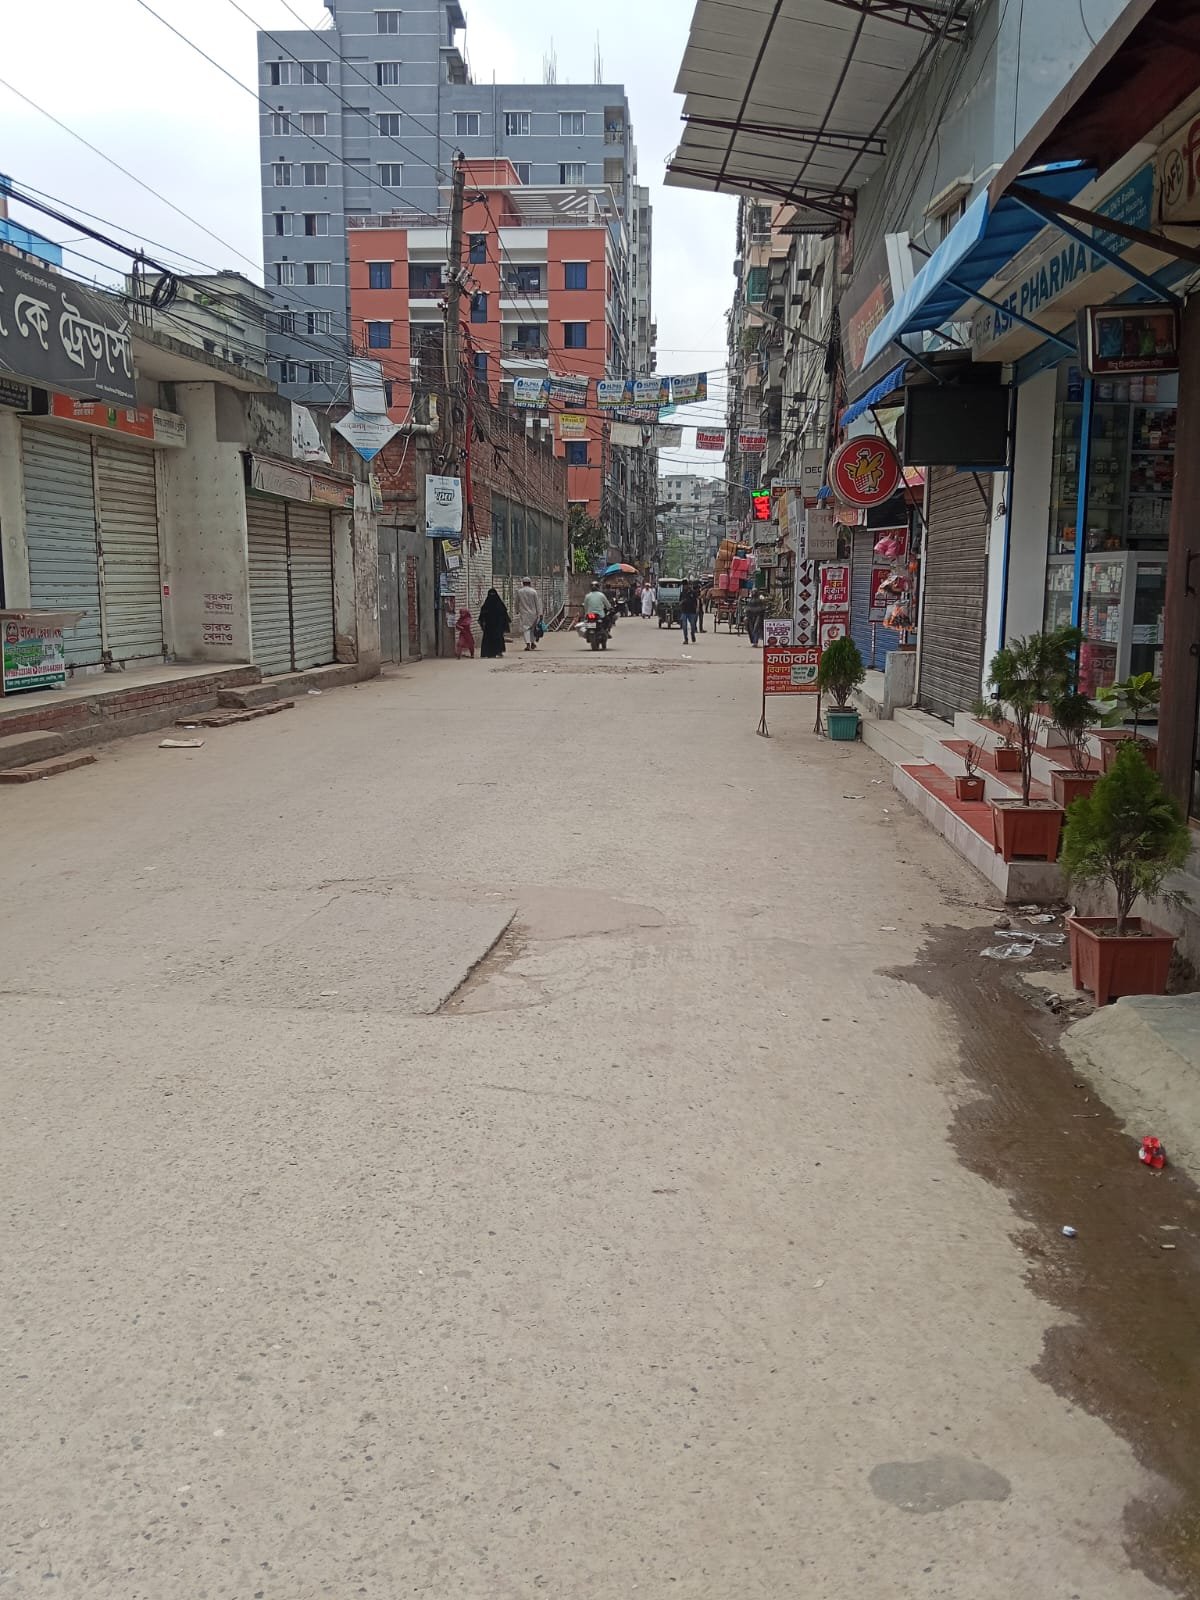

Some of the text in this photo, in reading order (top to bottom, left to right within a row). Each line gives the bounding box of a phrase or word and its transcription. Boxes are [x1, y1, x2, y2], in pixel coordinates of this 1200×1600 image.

[1020, 241, 1087, 317] PHARMA
[59, 292, 131, 379] ট্রেডার্স
[202, 623, 233, 632] ভারত
[767, 649, 819, 664] ফটোকপি
